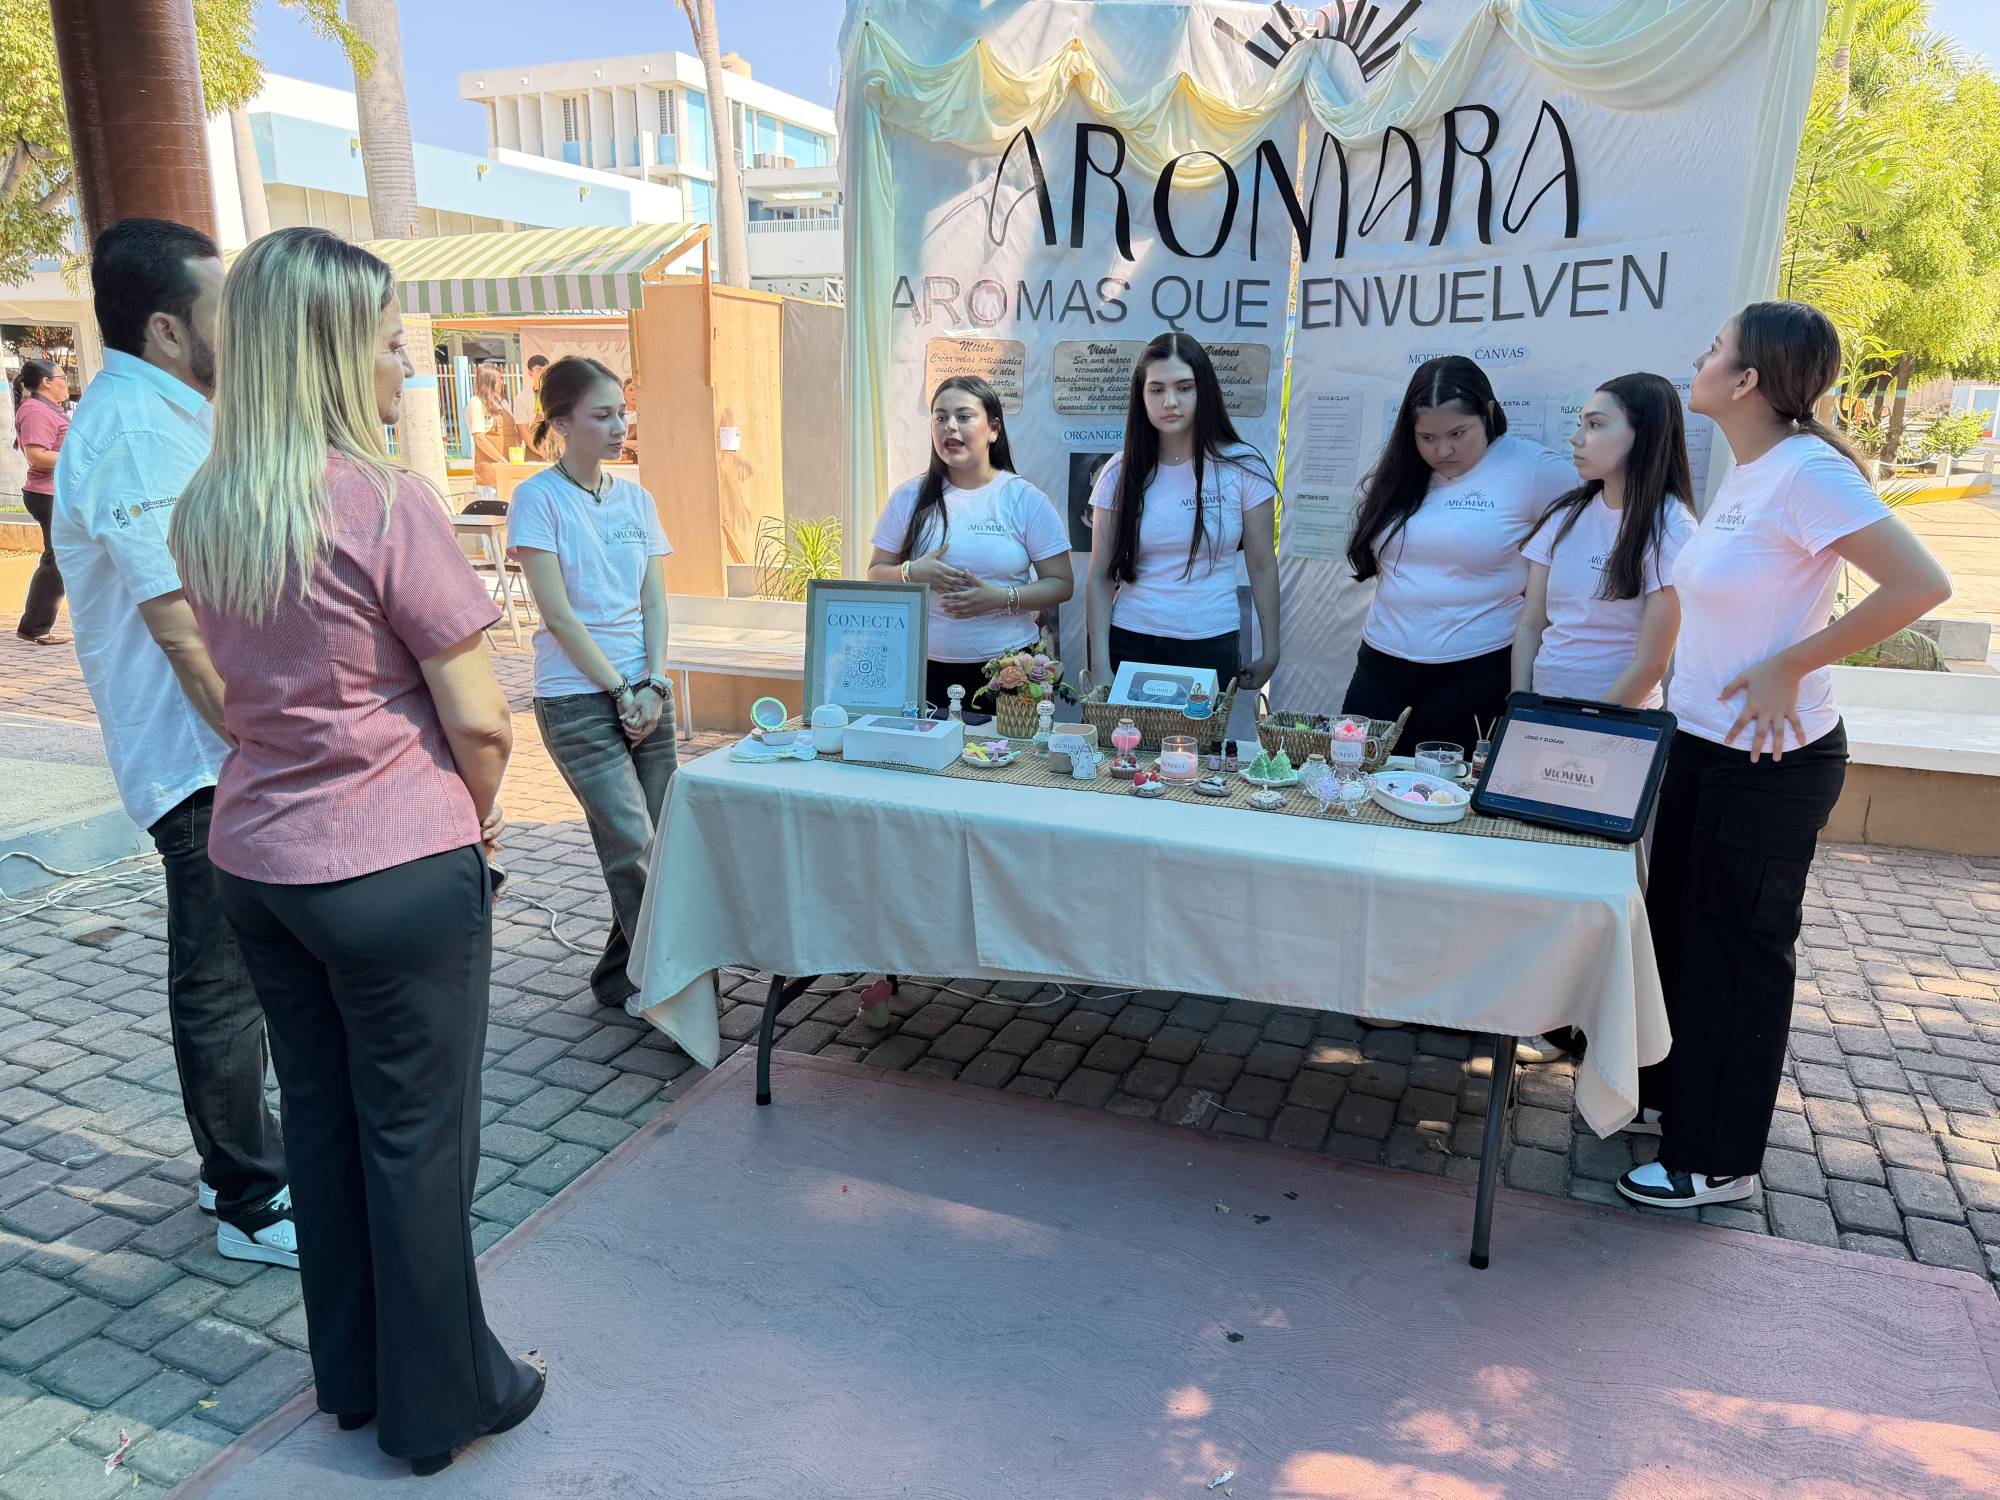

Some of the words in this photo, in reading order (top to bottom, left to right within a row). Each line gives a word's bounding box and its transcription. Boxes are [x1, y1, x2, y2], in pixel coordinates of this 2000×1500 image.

[988, 100, 1579, 263] AROMARA
[892, 275, 1131, 327] AROMAS
[1152, 275, 1271, 331] QUE
[1302, 251, 1668, 330] ENVUELVEN
[959, 341, 994, 353] Misión
[1087, 344, 1118, 355] Visión
[1205, 345, 1240, 357] Valores
[1474, 347, 1525, 361] CANVAS
[979, 356, 1022, 365] artesanales
[1072, 356, 1088, 365] Ser
[1108, 357, 1131, 365] marca
[987, 366, 997, 375] de
[999, 367, 1016, 376] alta
[1074, 365, 1114, 374] reconocida
[1115, 366, 1129, 375] por
[1213, 363, 1239, 372] alidad
[1054, 374, 1100, 385] transformar
[1102, 375, 1132, 386] espacio
[1068, 385, 1097, 393] aromas
[1058, 402, 1098, 412] innovación
[1063, 430, 1123, 440] ORGANIGR
[1444, 499, 1495, 509] AROMARA
[827, 613, 905, 630] CONECTA
[1524, 733, 1539, 741] LOGO
[1544, 737, 1565, 745] SLOGAN
[1541, 767, 1594, 785] AROMARA
[271, 1230, 290, 1245] alo
